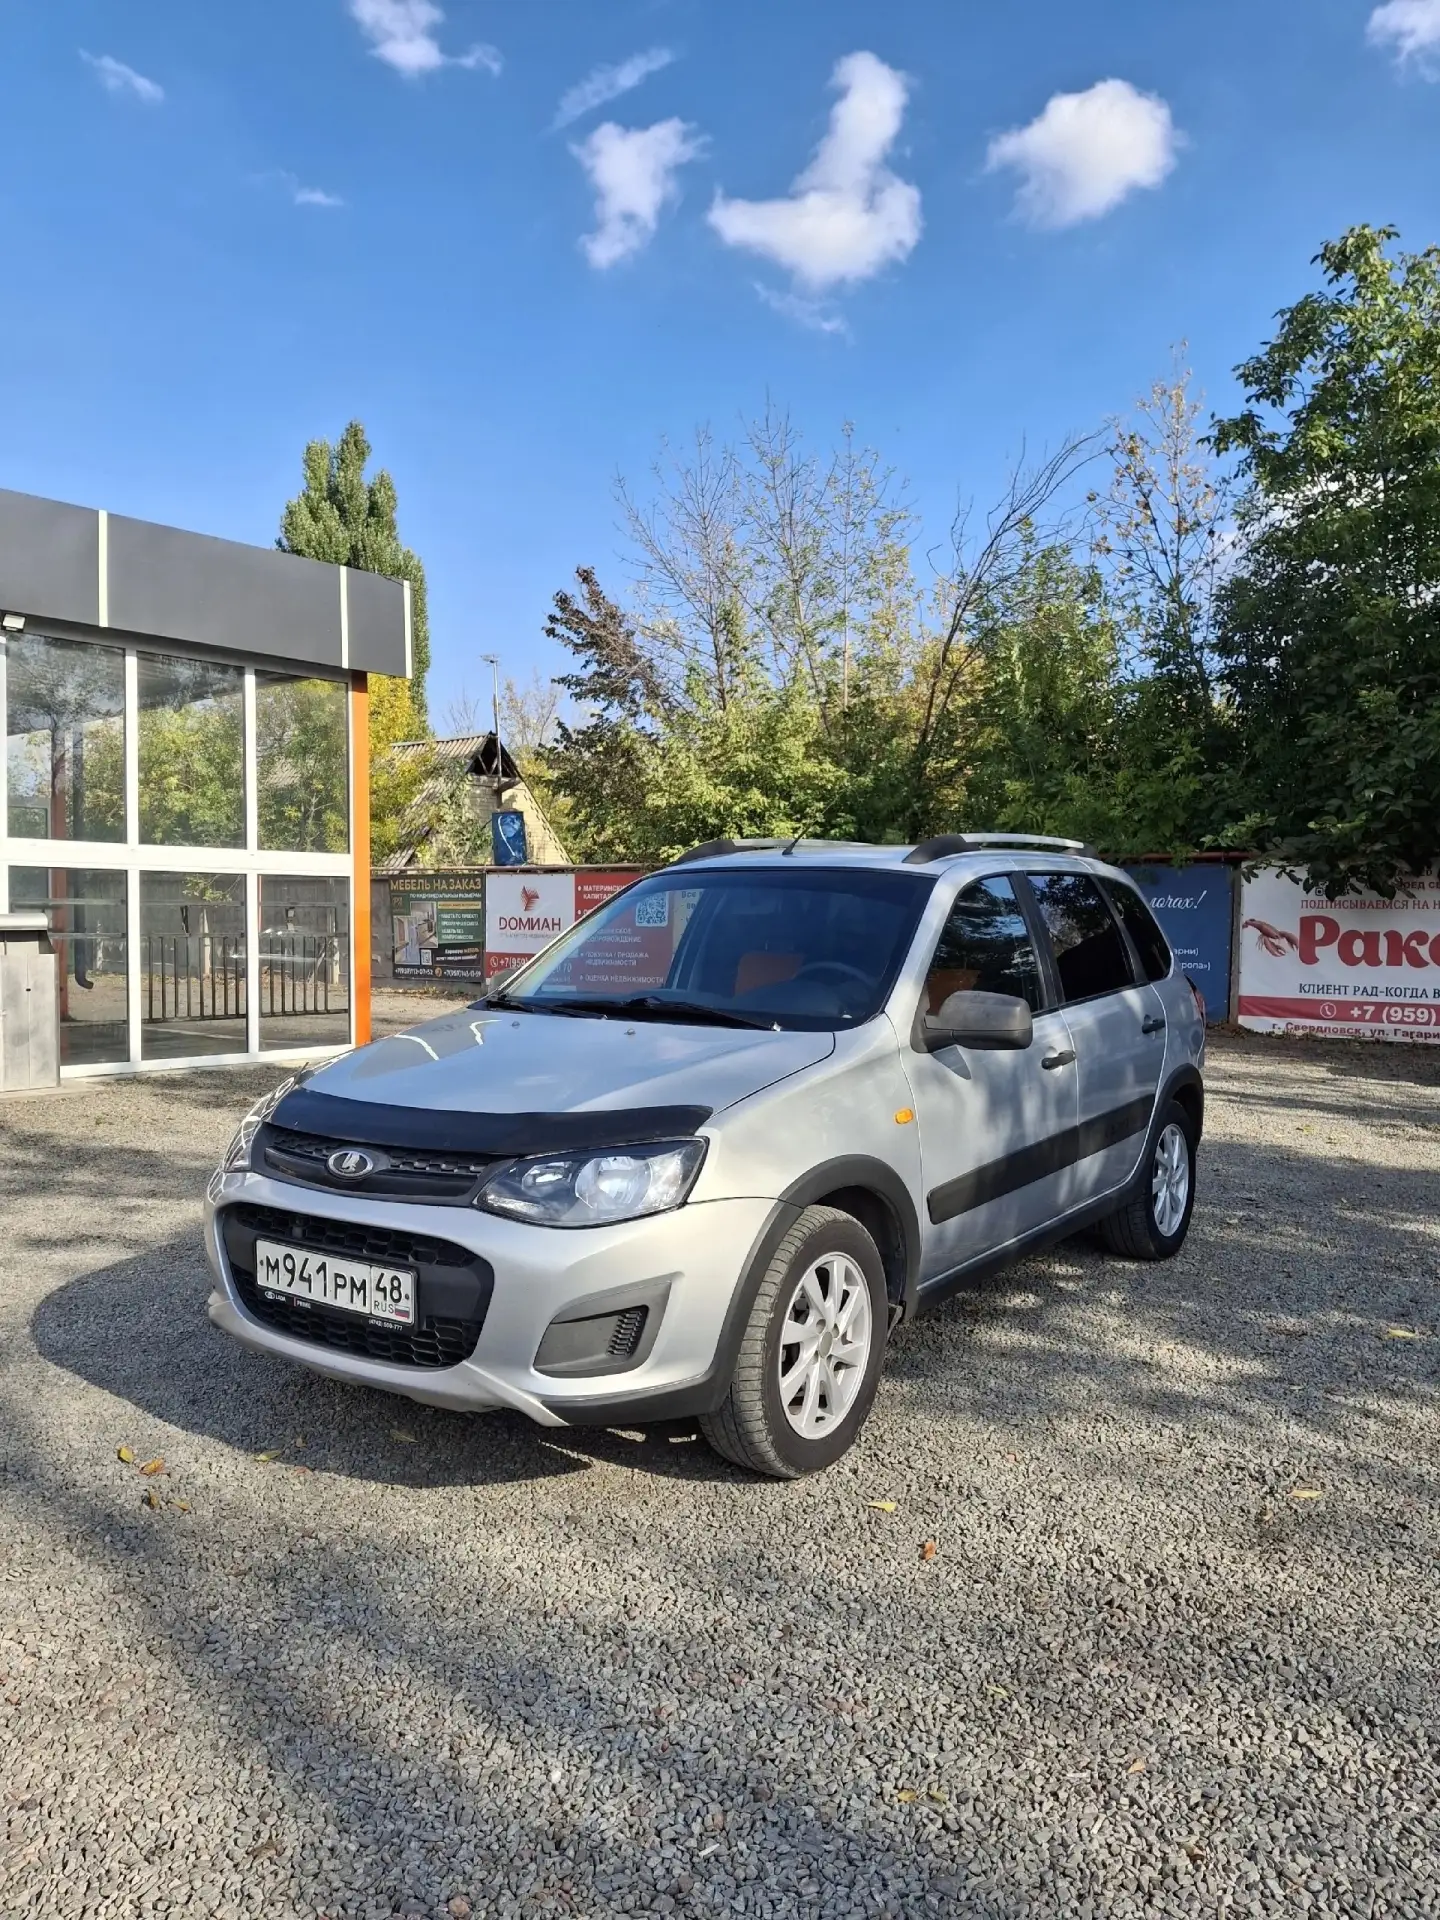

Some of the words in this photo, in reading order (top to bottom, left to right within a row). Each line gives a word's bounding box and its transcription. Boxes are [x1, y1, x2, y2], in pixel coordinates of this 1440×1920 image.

[391, 878, 431, 890] МЕБЕЛЬ
[433, 878, 448, 890] НА
[449, 877, 482, 890] ЗАКАЗ
[1301, 899, 1409, 909] ПОДПИСЫВАЕМСЯ
[1412, 900, 1429, 910] НА
[1299, 983, 1350, 995] КЛИЕНТ
[1353, 985, 1428, 999] РАД-КОГДА
[1350, 1005, 1375, 1020] +7
[1382, 1006, 1436, 1027] (959)
[1285, 1022, 1365, 1037] Свердловск,
[1369, 1026, 1389, 1037] ул.
[375, 1272, 403, 1303] 48
[374, 1302, 394, 1314] RUS
